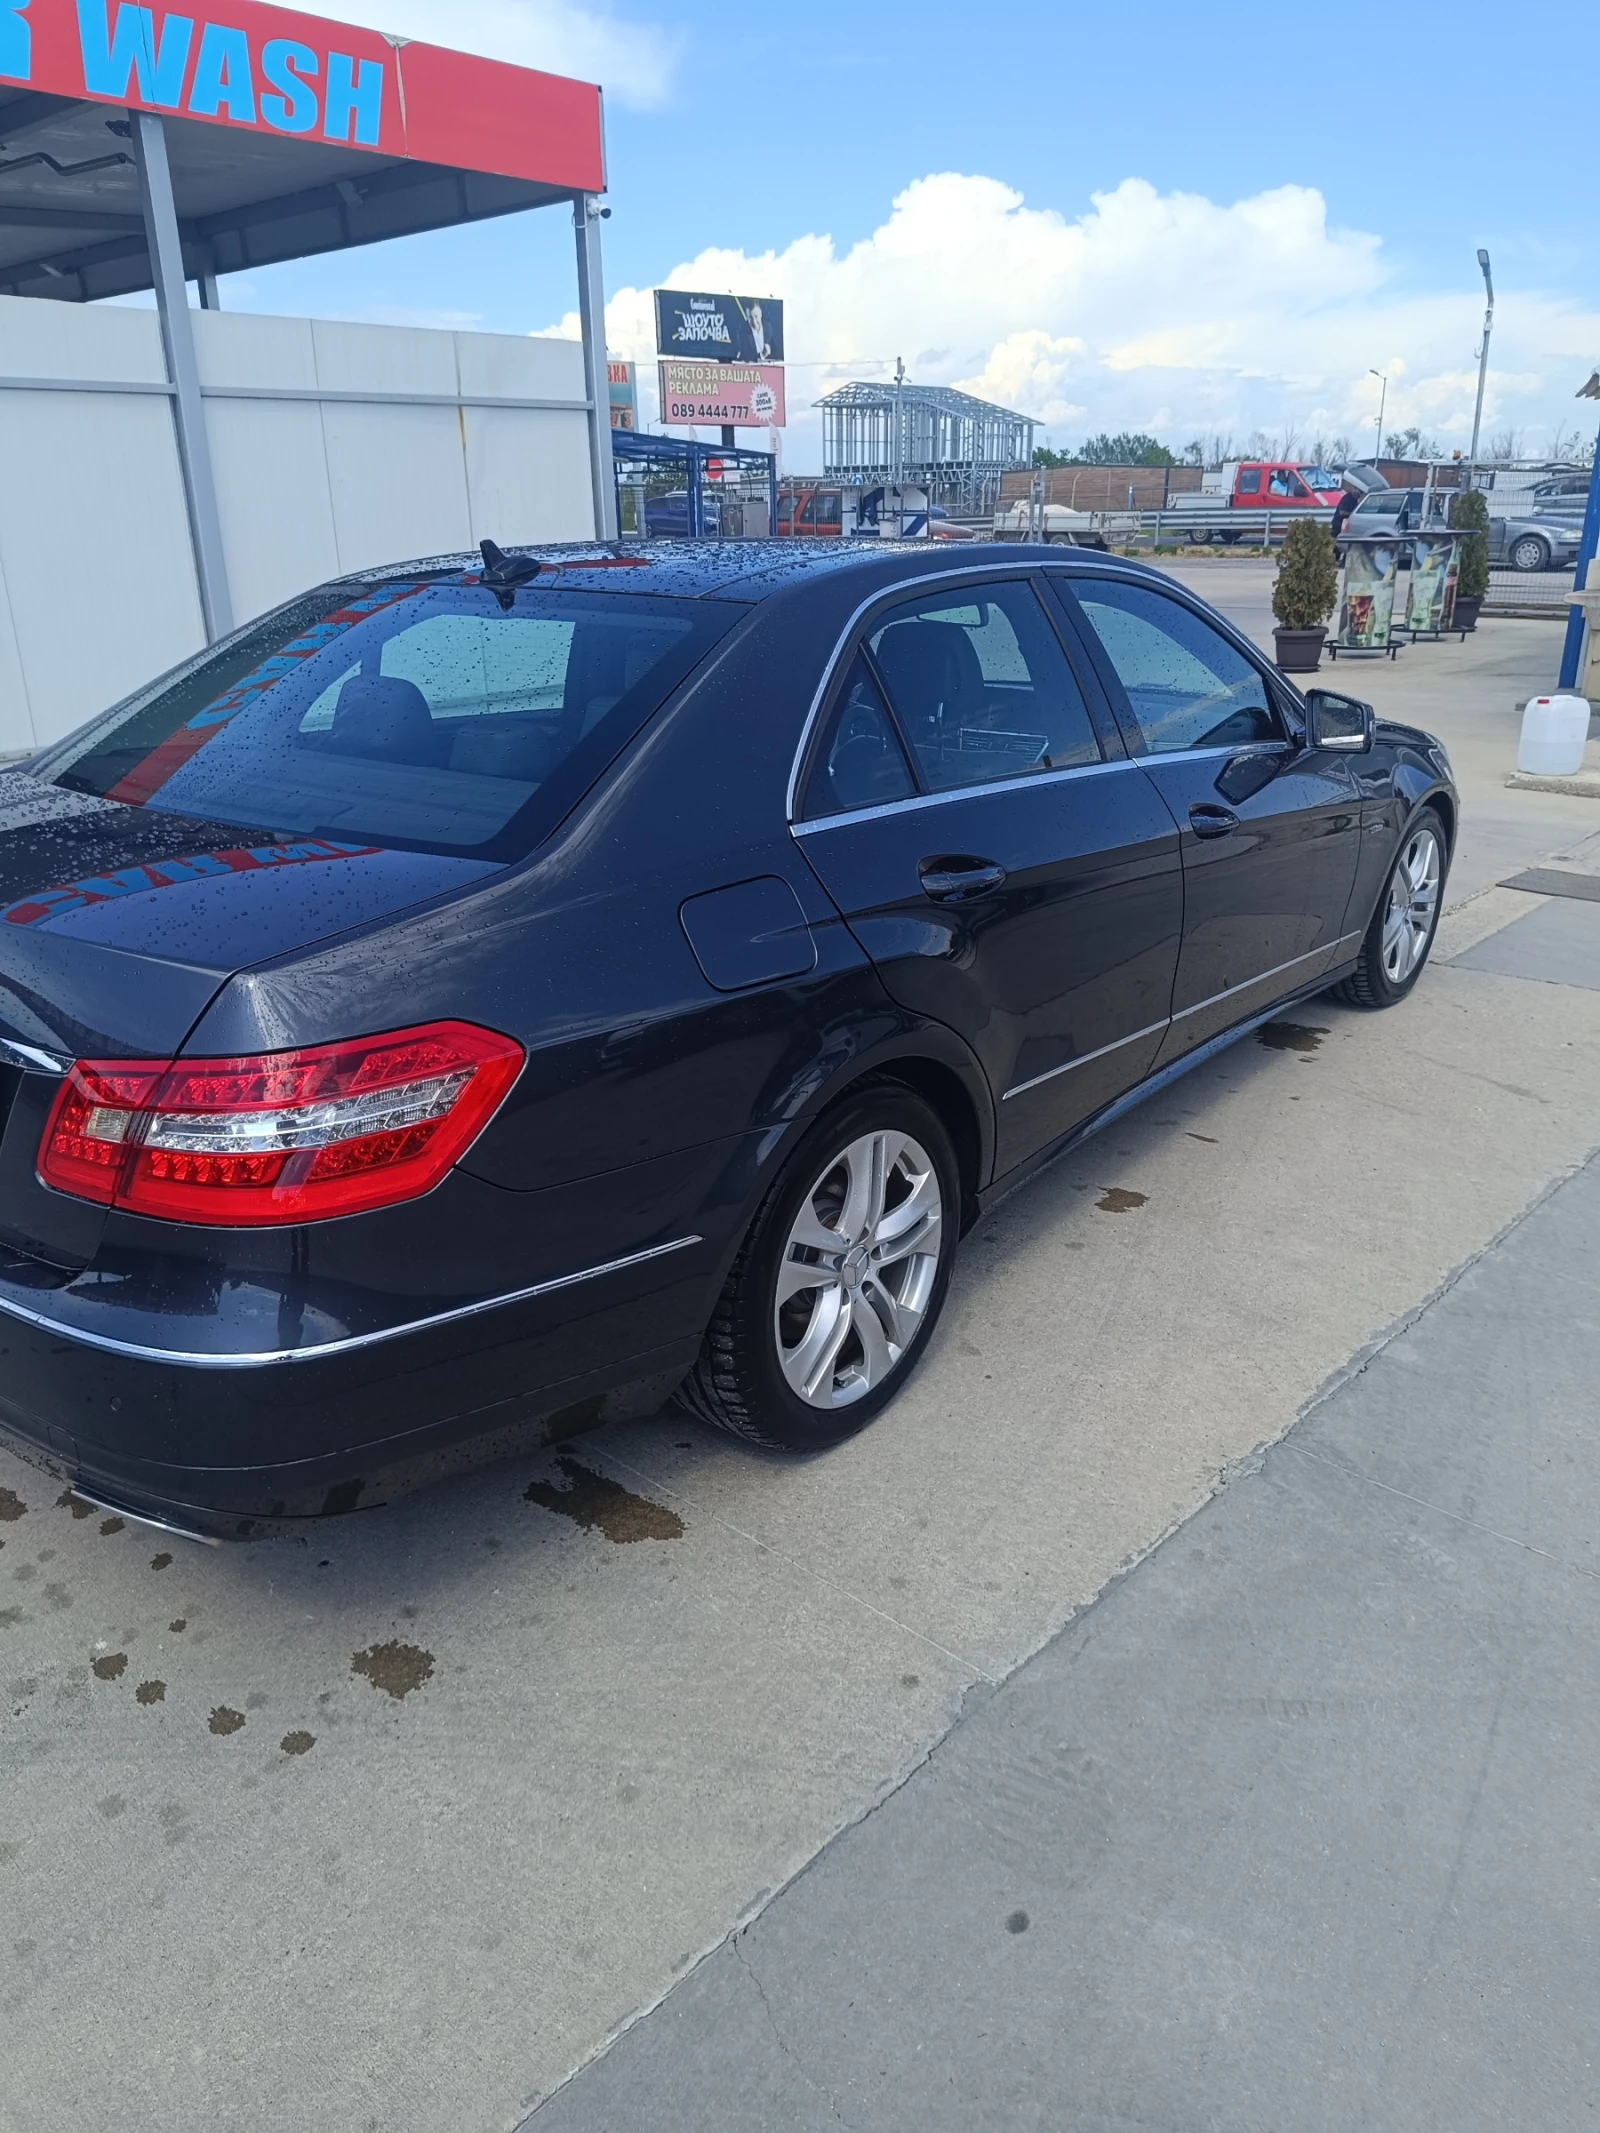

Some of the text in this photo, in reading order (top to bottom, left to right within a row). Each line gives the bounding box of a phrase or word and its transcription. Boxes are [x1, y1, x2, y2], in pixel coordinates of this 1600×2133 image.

[77, 0, 384, 146] WASH
[682, 313, 724, 328] ШОУТО
[678, 326, 730, 341] ЗАПОЧВА
[668, 366, 762, 383] МЯСТО ЗА ВАШАТА
[669, 381, 719, 396] РЕКЛАМА
[672, 403, 695, 417] 089
[698, 404, 729, 418] 4444
[730, 405, 749, 419] 777
